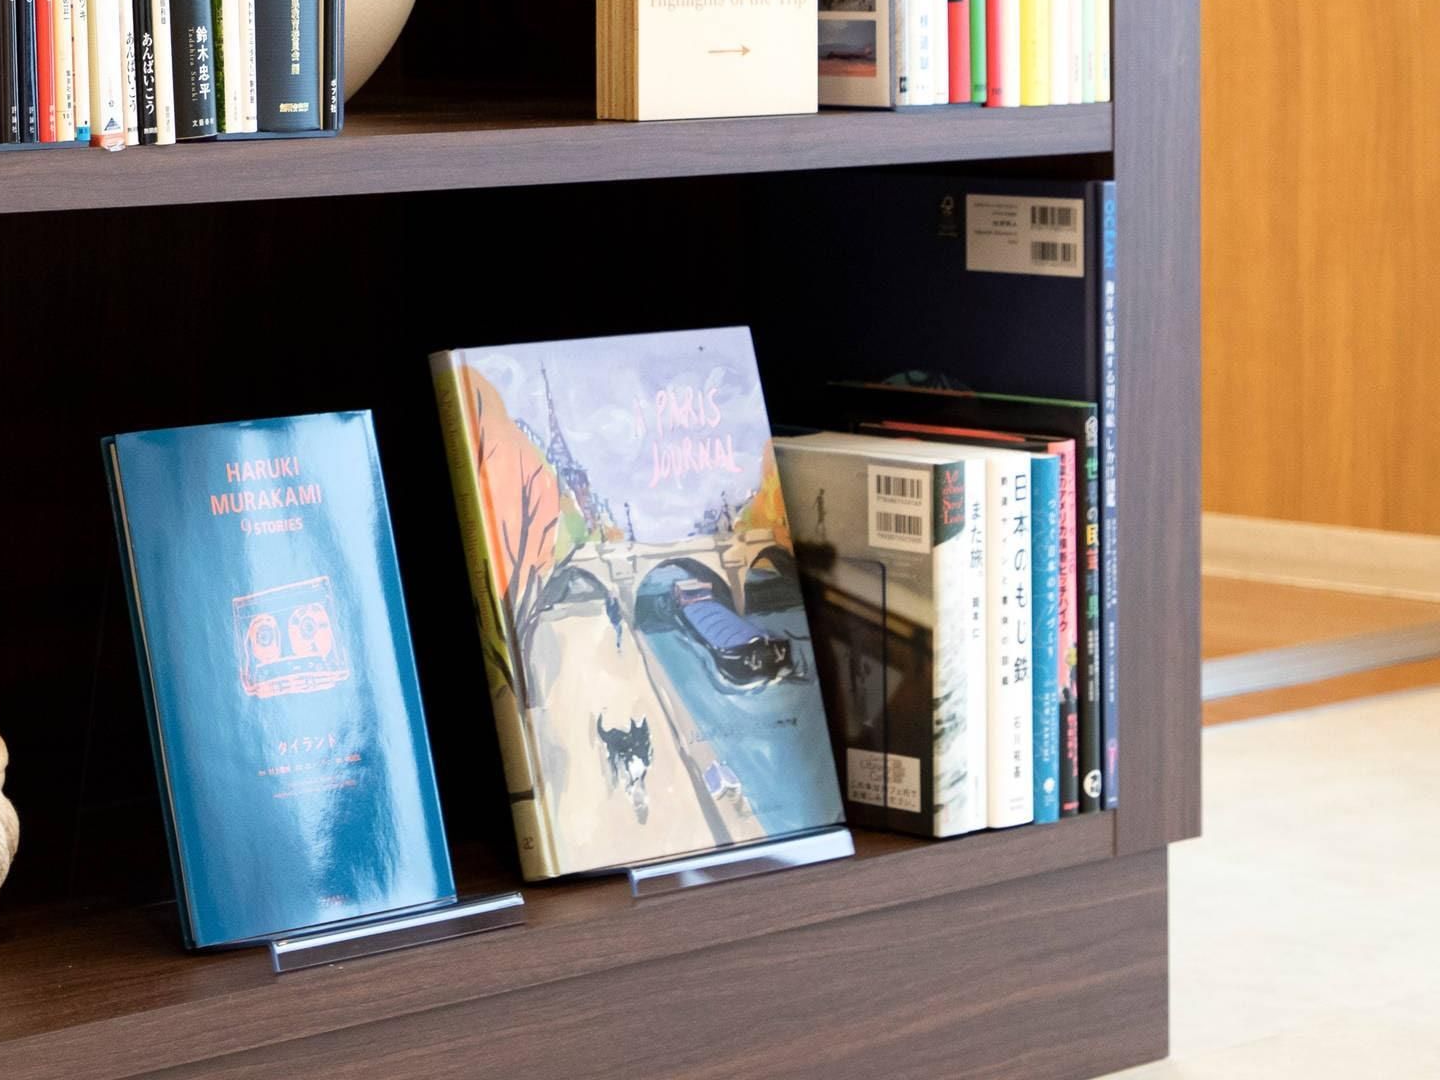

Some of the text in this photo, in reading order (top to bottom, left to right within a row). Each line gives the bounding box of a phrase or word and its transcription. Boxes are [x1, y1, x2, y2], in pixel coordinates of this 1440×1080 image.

[142, 32, 155, 115] あんばいこう
[195, 26, 212, 101] 鈴木忠平
[655, 385, 722, 440] PARIS
[226, 456, 300, 483] HARUKI
[648, 433, 744, 489] JOURNAL
[210, 484, 322, 516] MURAKAMI
[254, 517, 304, 536] STORIES
[1013, 474, 1029, 685] 日本のもじ鉄
